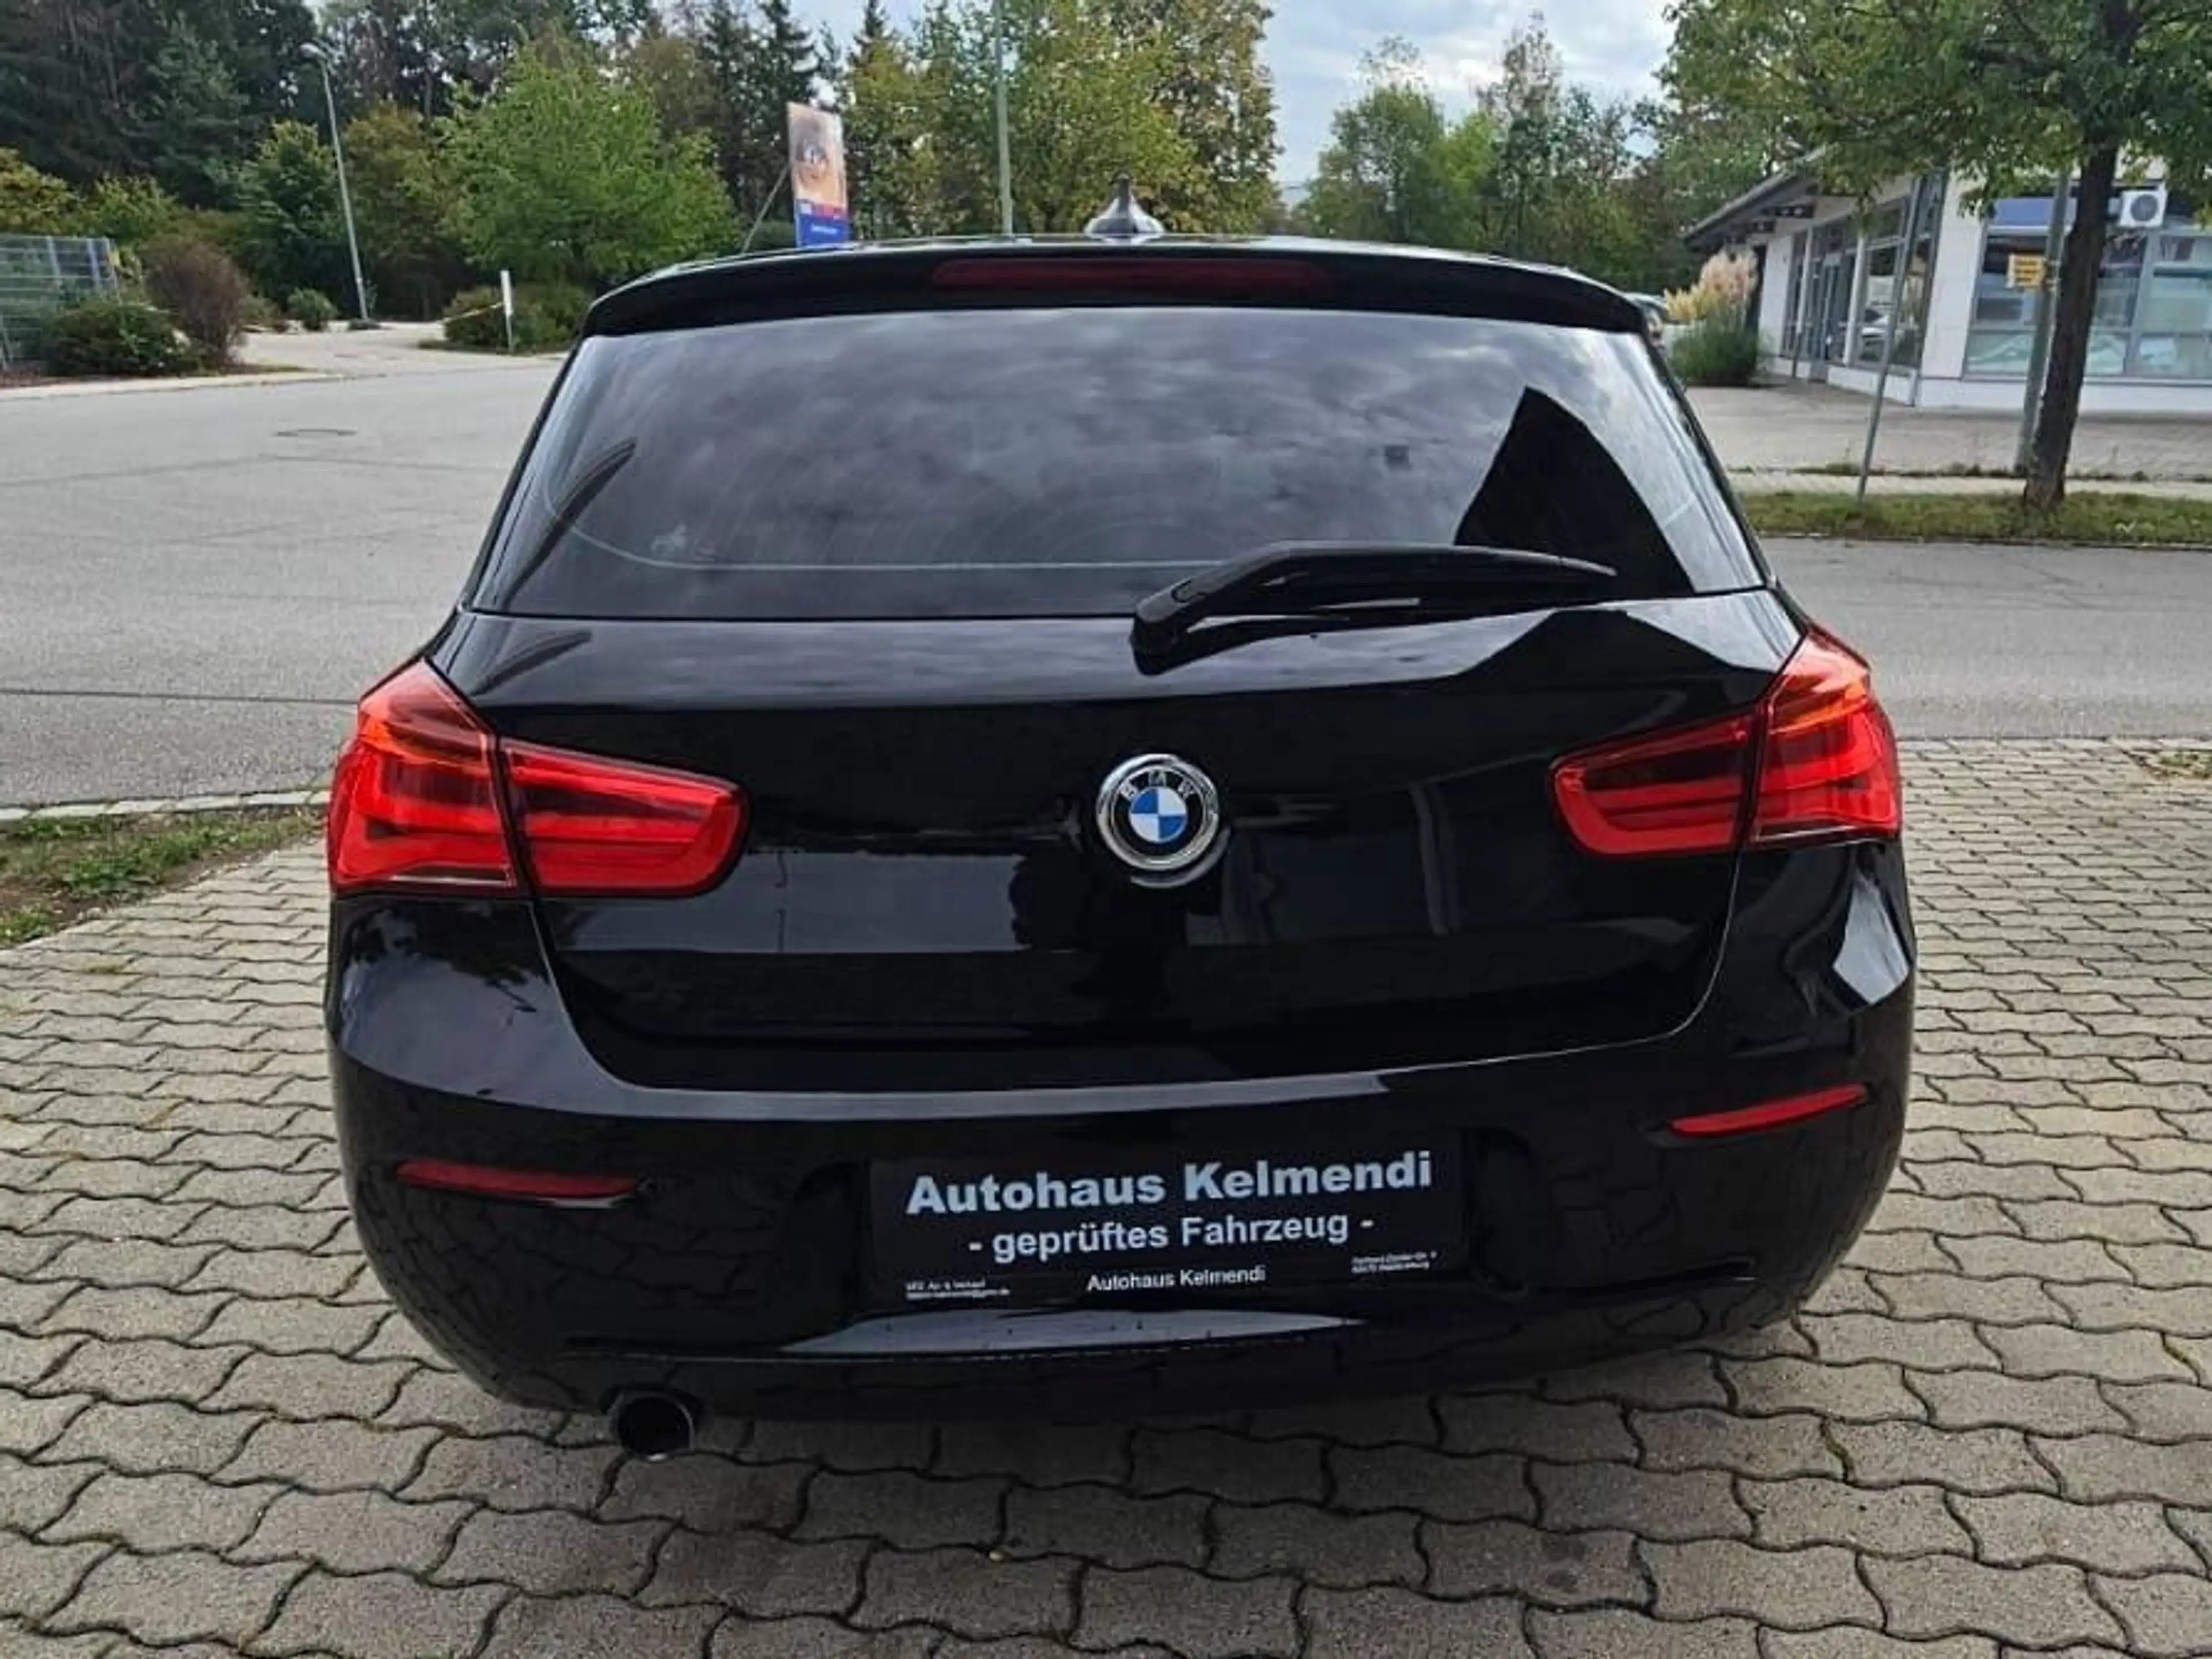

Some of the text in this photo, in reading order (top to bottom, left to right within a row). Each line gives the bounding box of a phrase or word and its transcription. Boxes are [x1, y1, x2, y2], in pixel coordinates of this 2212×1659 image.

[1120, 771, 1195, 801] BMW
[906, 1150, 1431, 1214] Autohaus Kelmendi
[992, 1221, 1169, 1264] geprüftes
[1181, 1214, 1348, 1246] Fahrzeug
[1087, 1265, 1266, 1291] Autohaus Kelmendi
